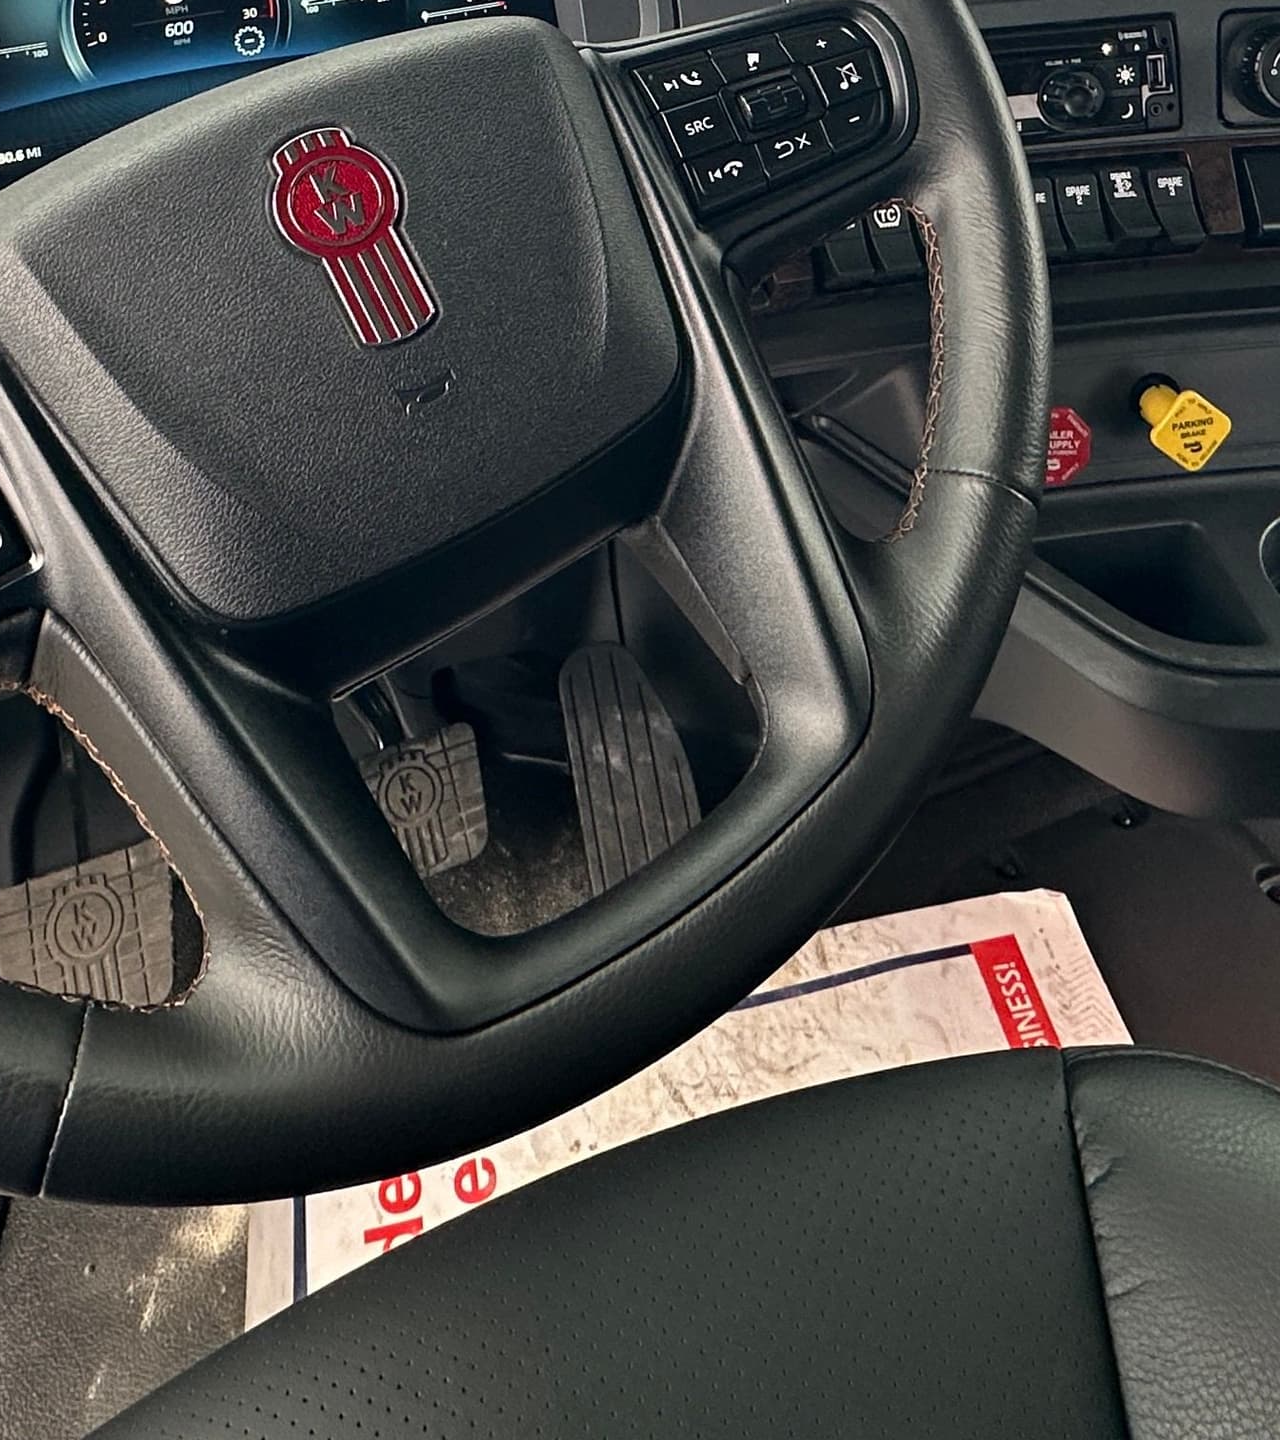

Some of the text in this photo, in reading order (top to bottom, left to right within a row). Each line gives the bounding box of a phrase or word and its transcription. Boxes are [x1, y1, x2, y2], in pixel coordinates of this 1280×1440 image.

[165, 5, 188, 16] MPH
[243, 8, 258, 19] 30
[165, 20, 194, 38] 600
[98, 32, 107, 43] 0
[32, 48, 49, 58] 100
[684, 116, 715, 136] SRC
[26, 147, 41, 159] MI
[1157, 176, 1184, 188] SPARE
[1065, 185, 1090, 197] SPARE
[1172, 417, 1213, 431] PARKING
[1049, 430, 1074, 439] ILER
[1181, 429, 1206, 439] BRAKE
[1049, 439, 1081, 449] UPPLY
